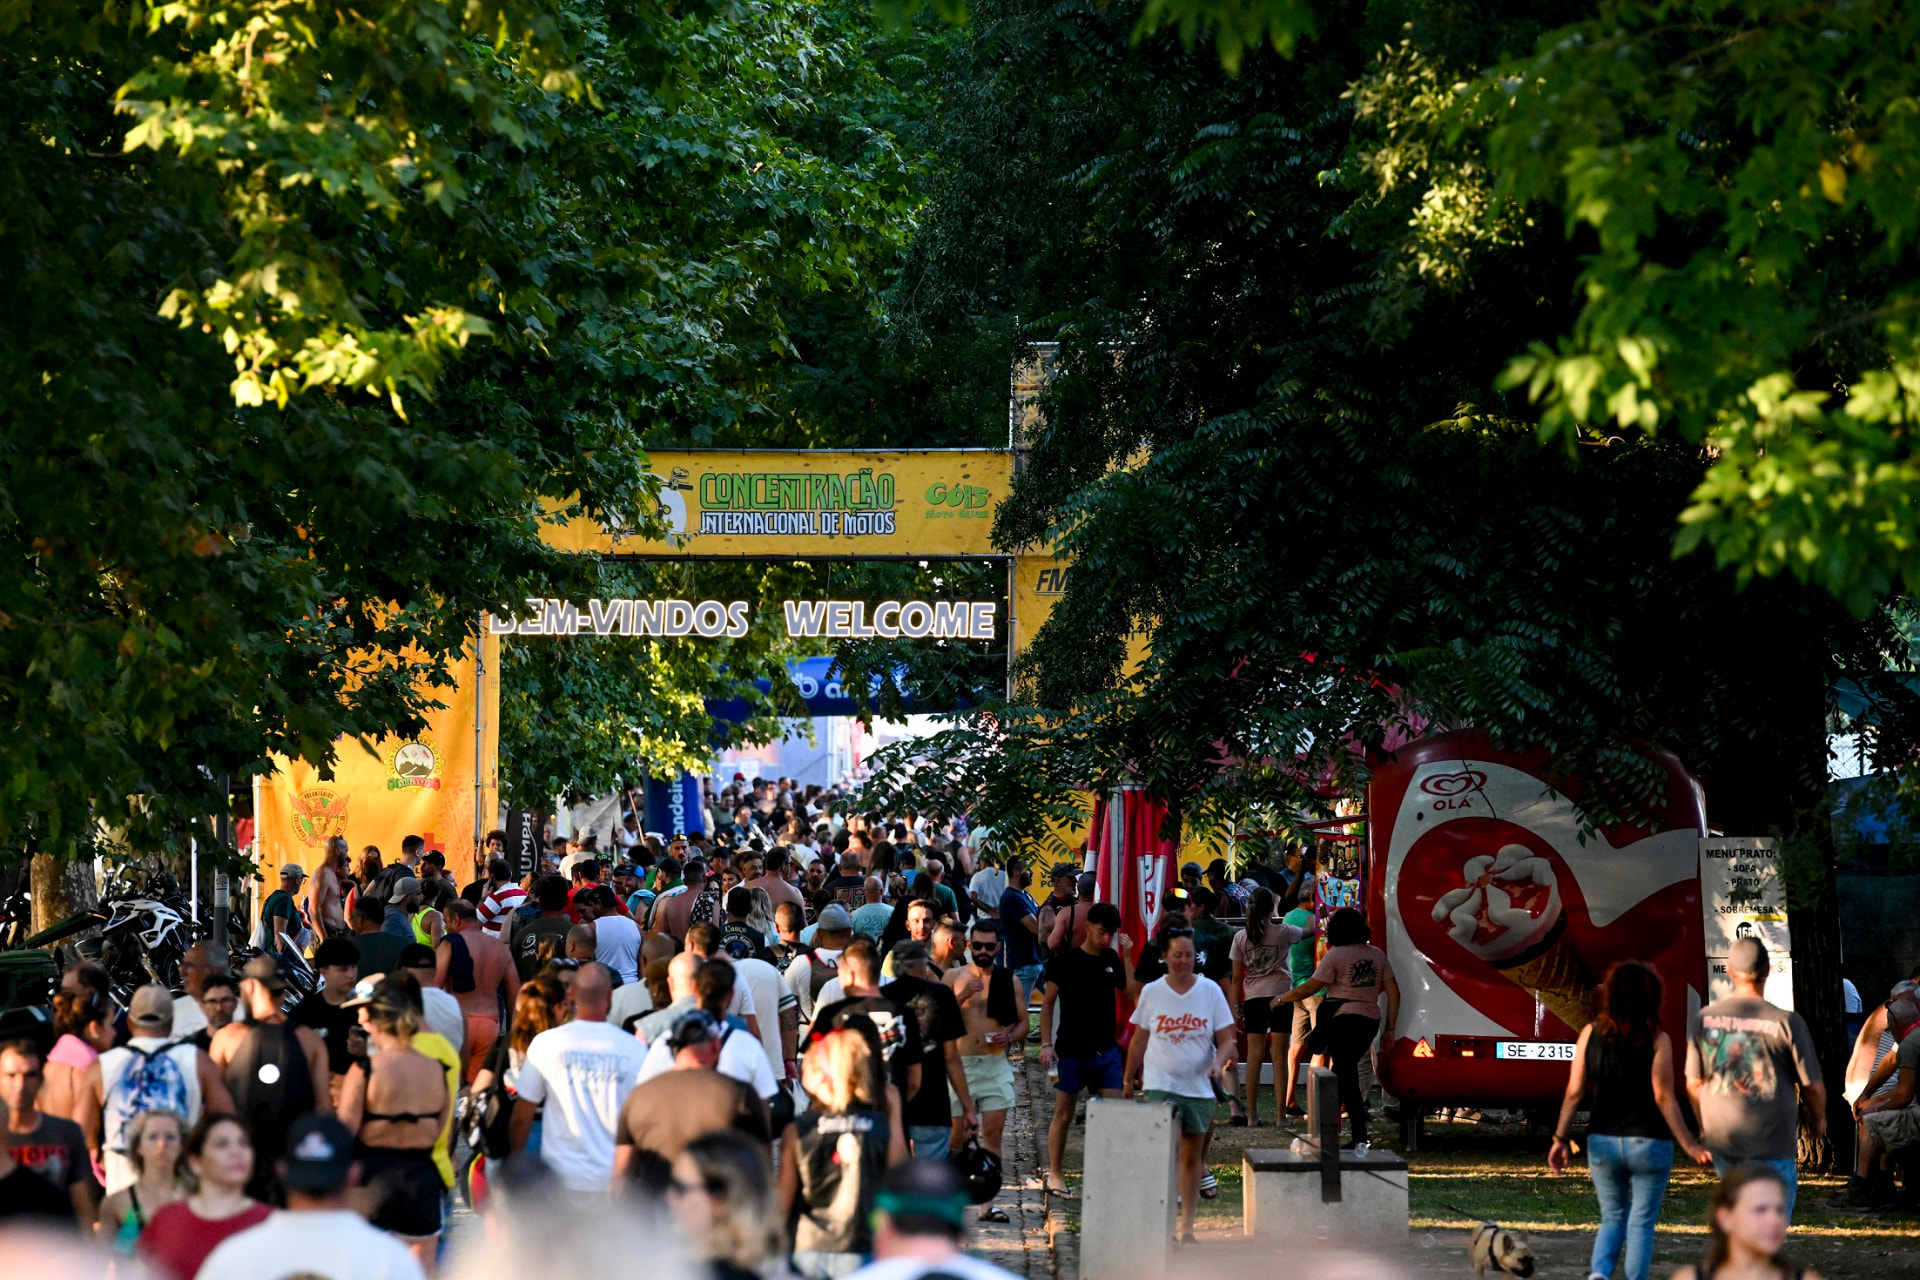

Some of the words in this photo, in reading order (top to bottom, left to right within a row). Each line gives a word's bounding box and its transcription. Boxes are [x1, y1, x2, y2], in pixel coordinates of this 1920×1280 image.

[700, 468, 895, 515] CONCENTRAÇÃO
[700, 511, 818, 534] INTERNACIONAL
[821, 511, 840, 534] DE
[843, 511, 896, 534] MOTOS
[784, 600, 995, 638] WELCOME
[1432, 795, 1472, 811] OLÁ
[1706, 849, 1736, 859] MENU
[1739, 849, 1776, 859] PRATO:
[1733, 864, 1756, 873] SOPA
[1731, 878, 1760, 887] PRATO
[1720, 905, 1774, 914] SOBREMESA
